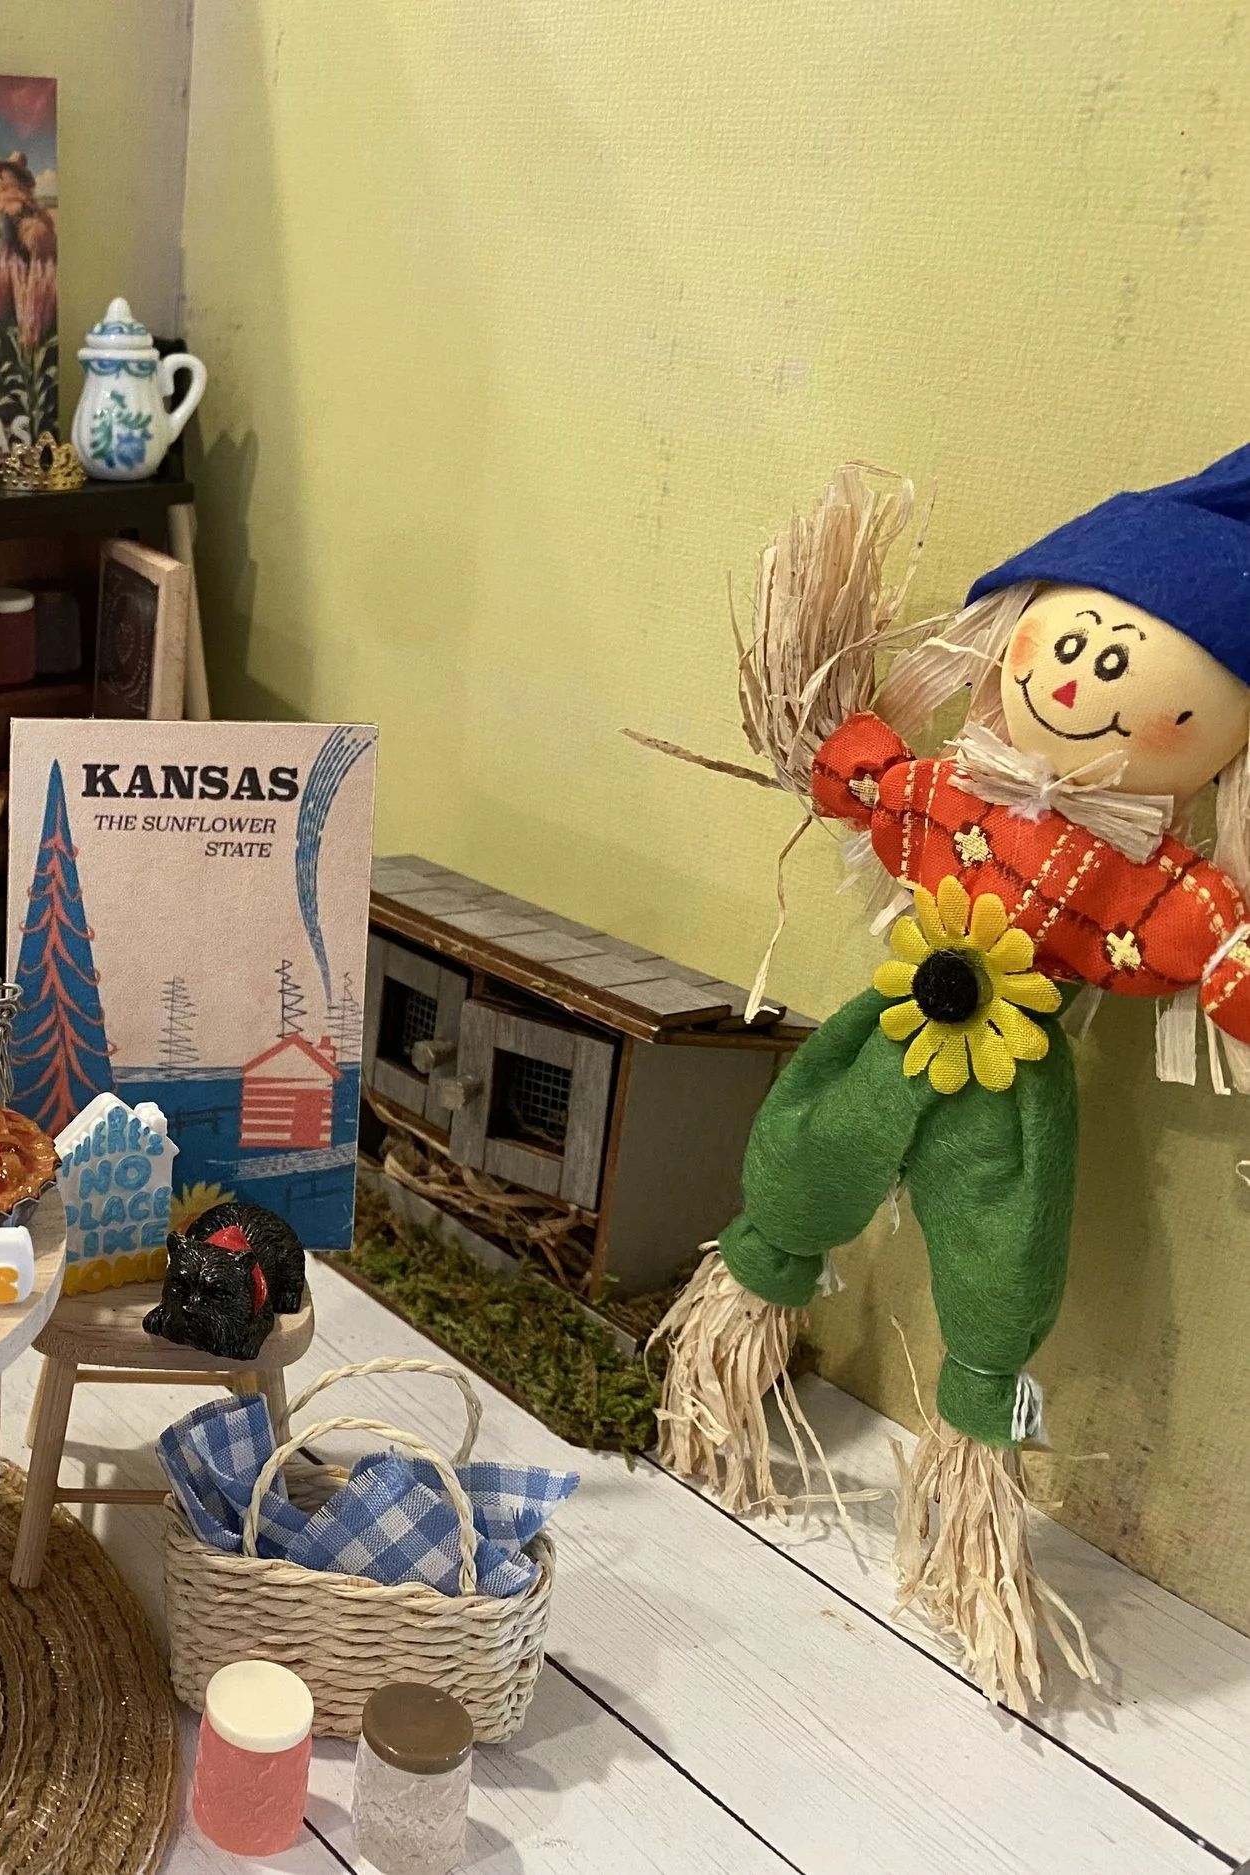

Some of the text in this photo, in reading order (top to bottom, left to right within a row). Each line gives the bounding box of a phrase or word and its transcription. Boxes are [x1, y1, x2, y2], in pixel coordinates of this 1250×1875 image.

[81, 763, 300, 802] KANSAS
[94, 814, 277, 834] THE SUNFLOWER
[204, 841, 272, 858] STATE
[78, 1154, 152, 1200] NO
